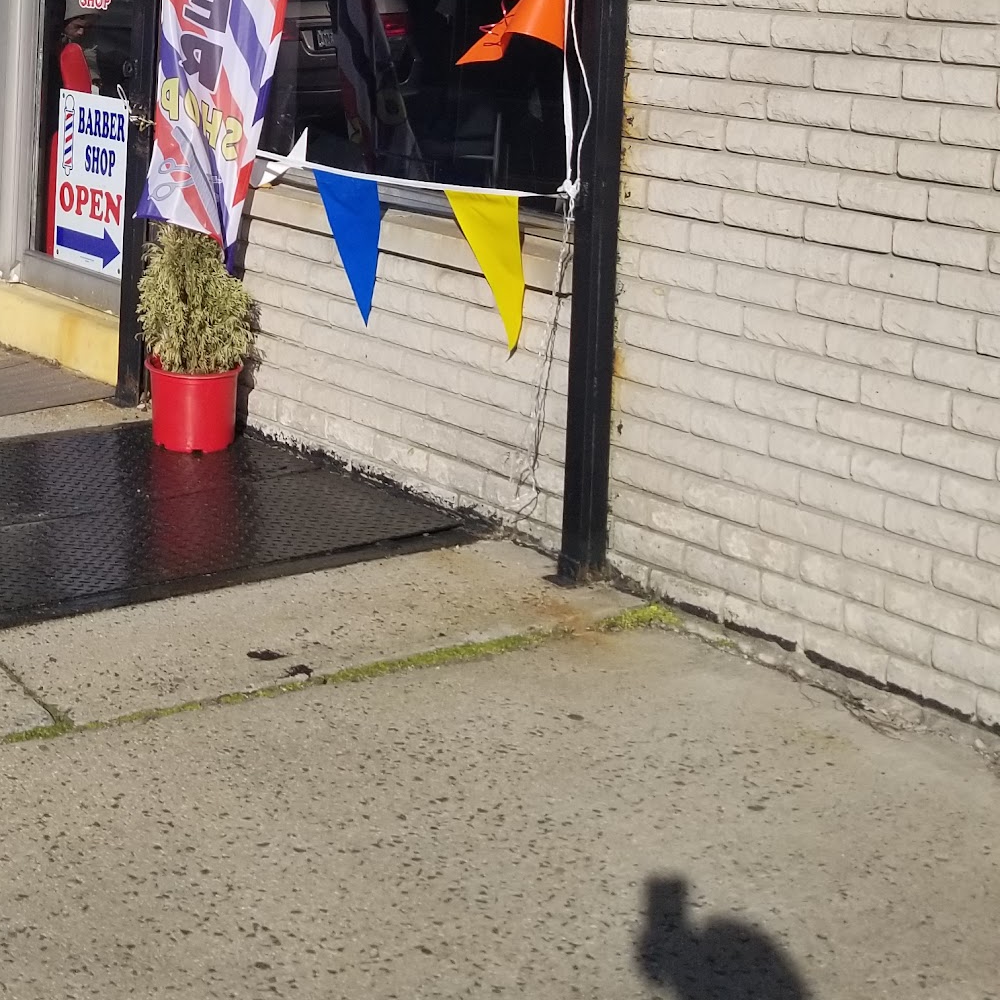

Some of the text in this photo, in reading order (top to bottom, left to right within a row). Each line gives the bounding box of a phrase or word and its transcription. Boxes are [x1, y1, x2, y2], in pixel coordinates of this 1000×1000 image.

[78, 106, 126, 142] BARBER
[85, 144, 116, 177] SHOP
[59, 181, 123, 226] OPEN
